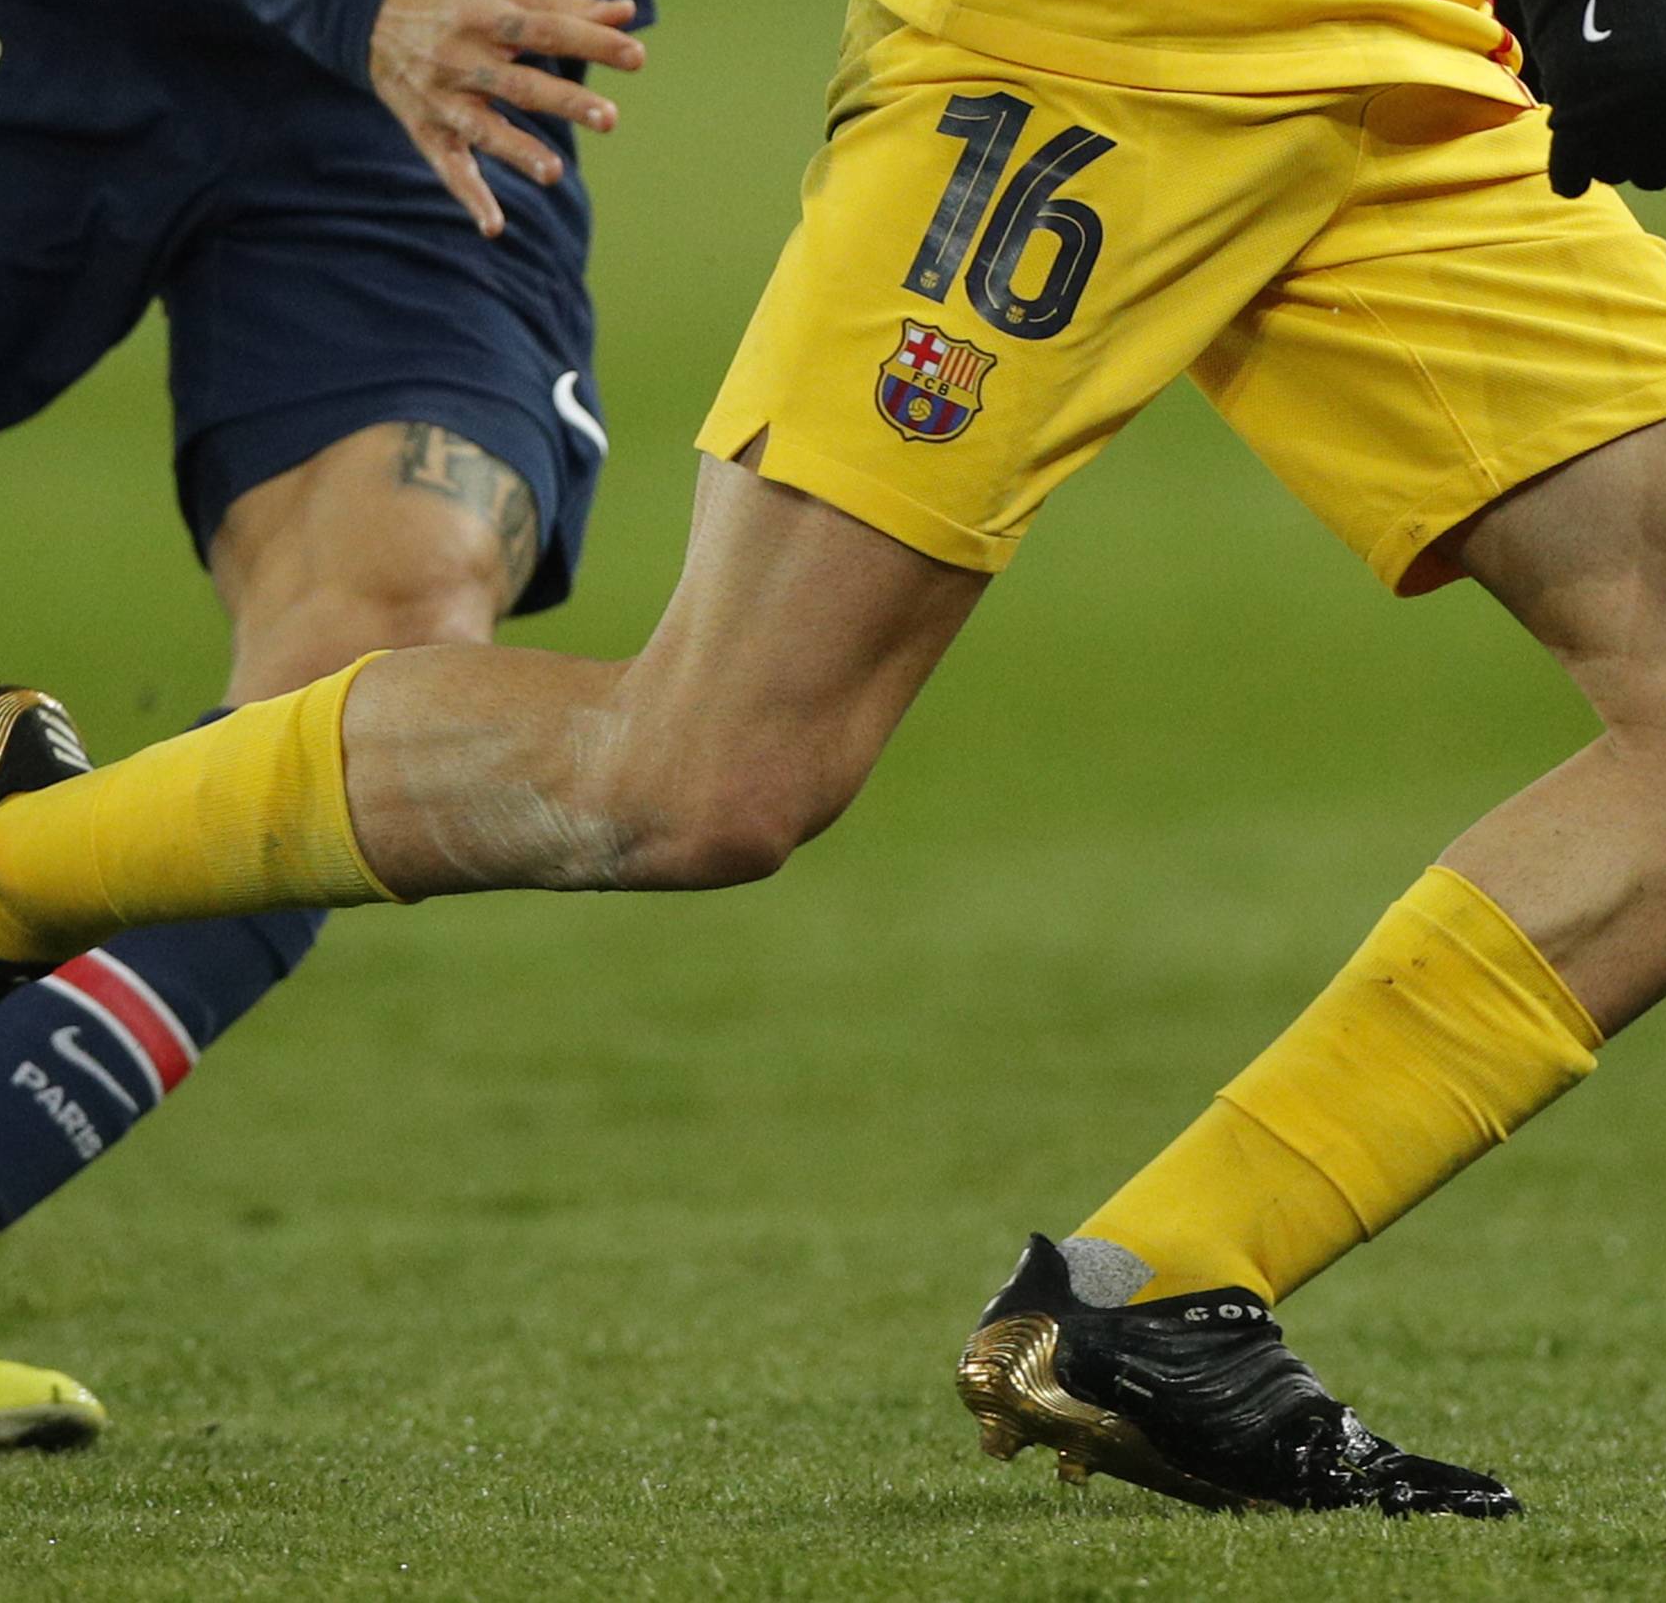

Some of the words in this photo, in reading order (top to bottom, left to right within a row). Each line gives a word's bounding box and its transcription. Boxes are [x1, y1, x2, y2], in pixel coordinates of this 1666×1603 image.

[900, 91, 1118, 340] 16
[911, 370, 950, 396] FCB
[12, 1060, 103, 1159] PARIS
